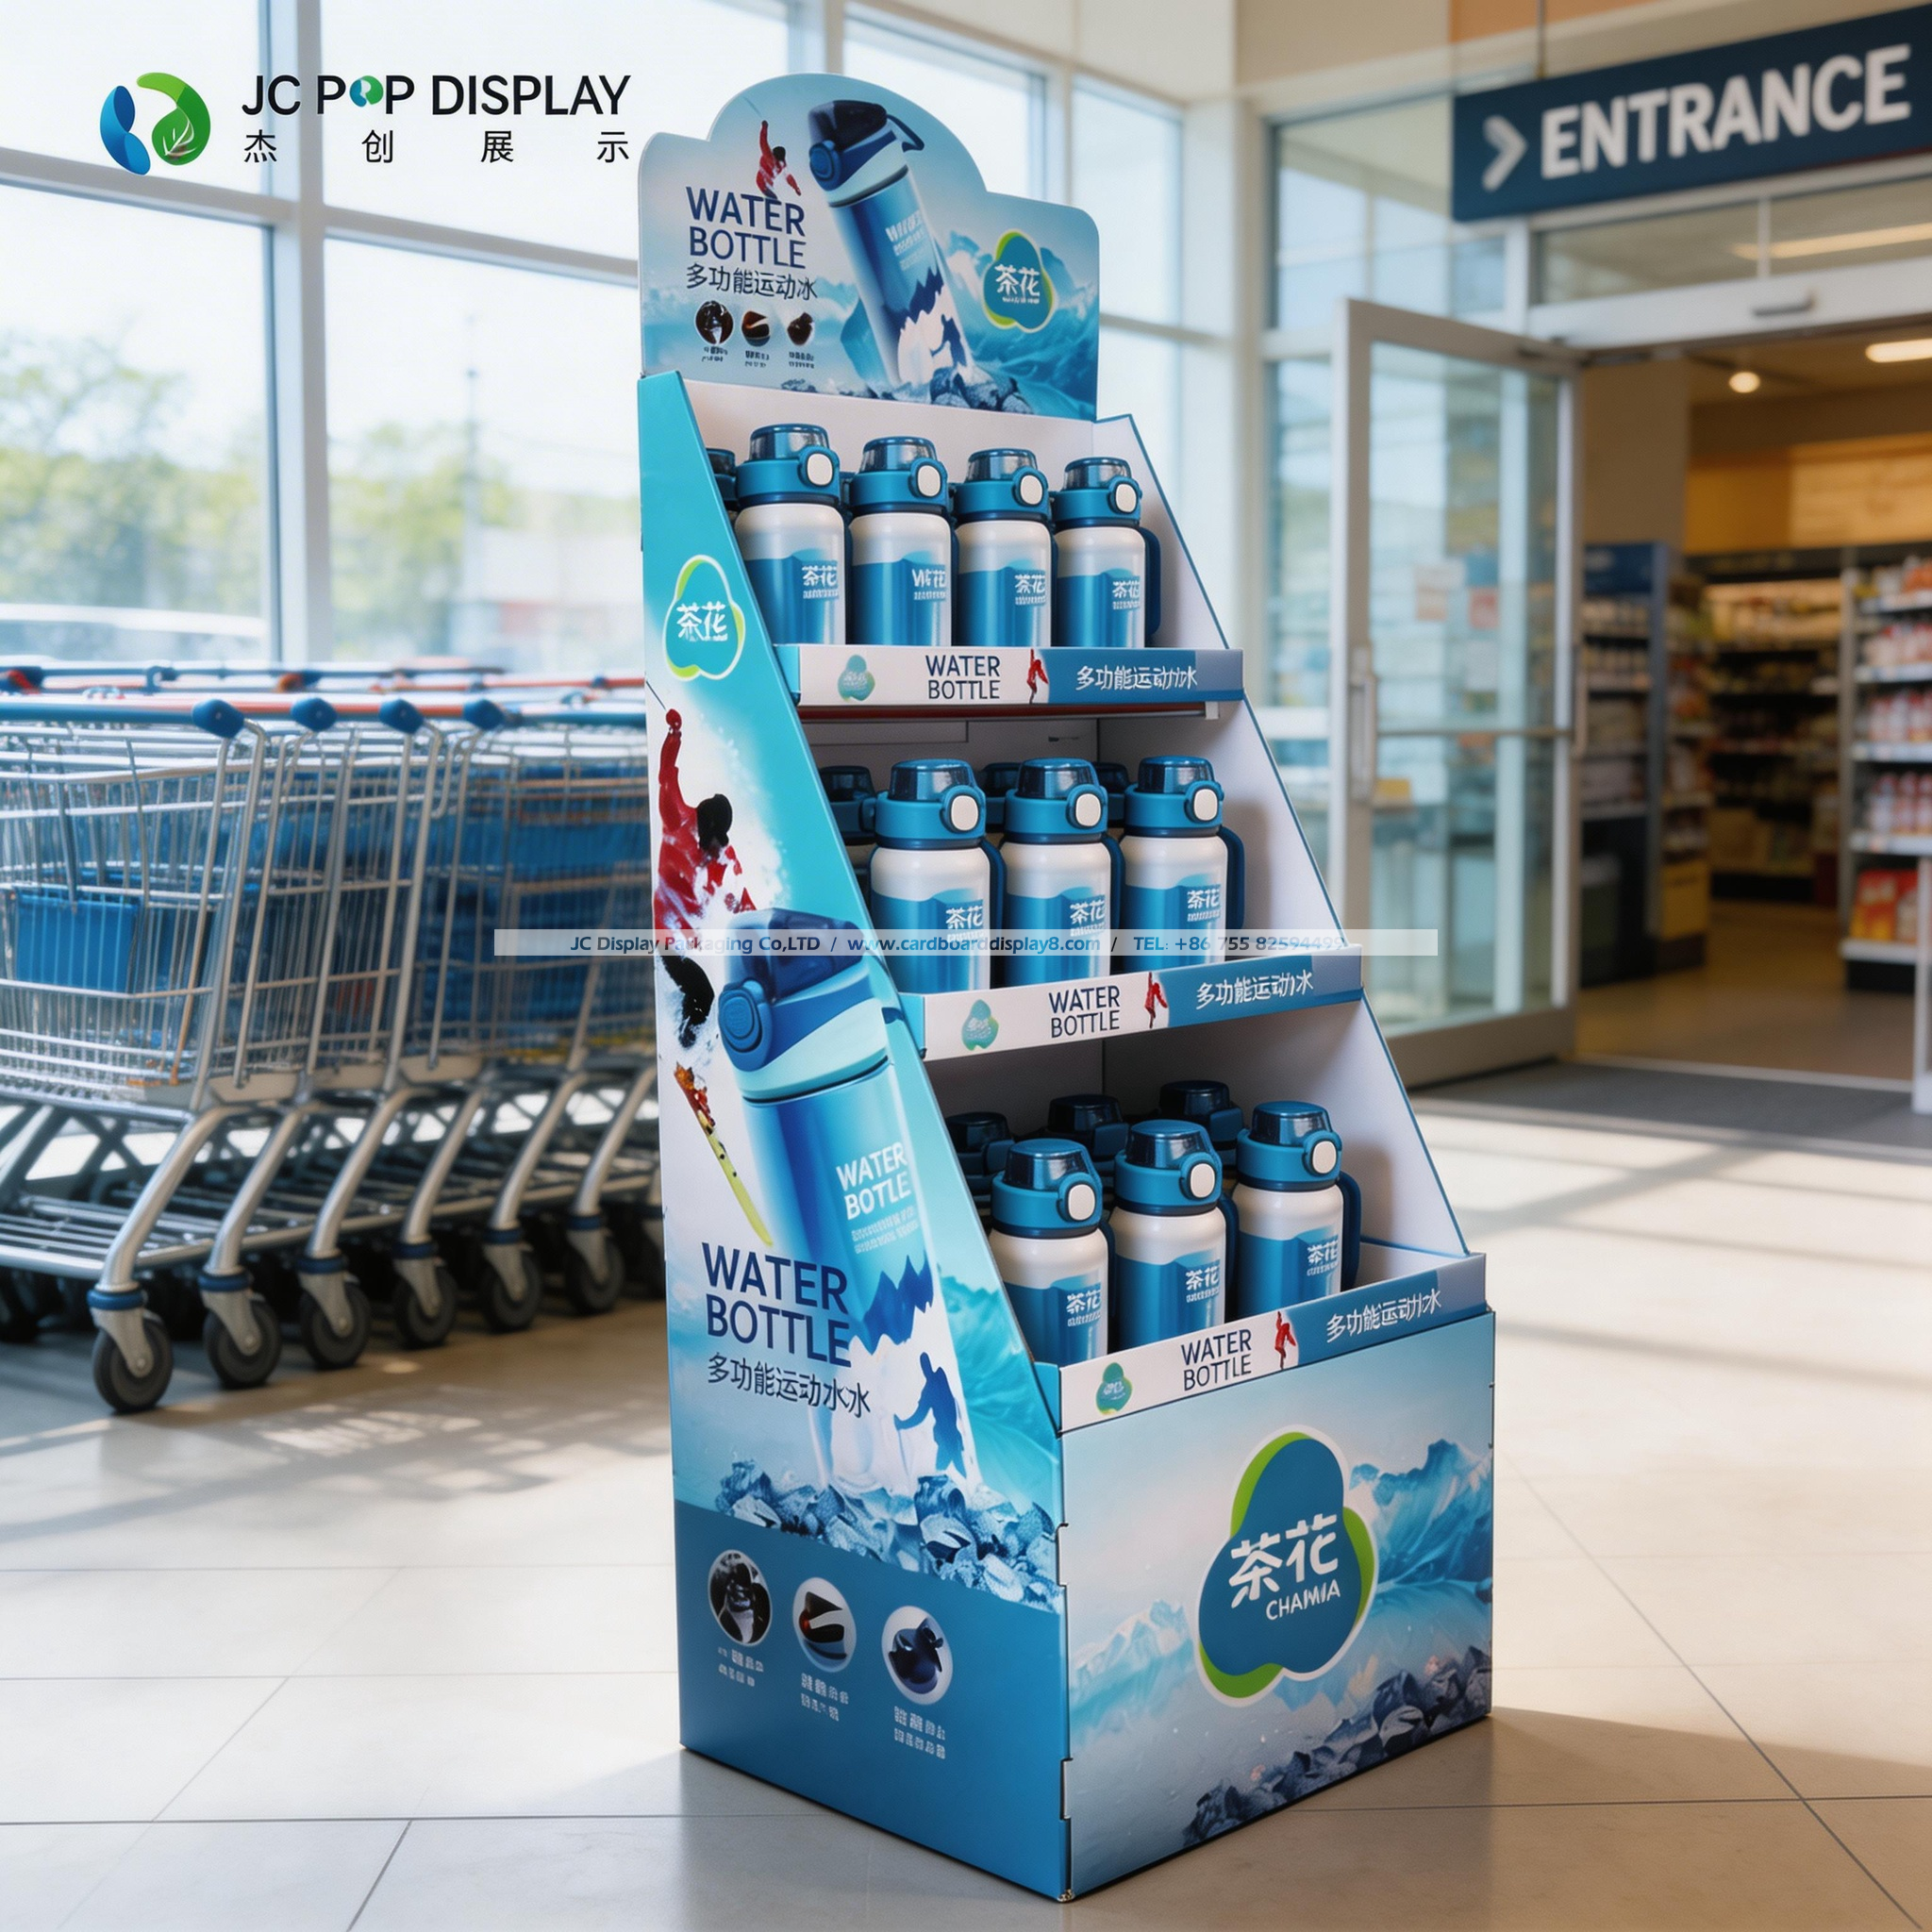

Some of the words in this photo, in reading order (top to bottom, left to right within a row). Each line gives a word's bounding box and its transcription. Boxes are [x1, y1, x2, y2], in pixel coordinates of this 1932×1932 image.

[1541, 43, 1911, 179] ENTRANCE
[686, 186, 806, 237] WATER
[690, 225, 807, 269] BOTTLE
[994, 263, 1041, 297] 茶花
[676, 601, 728, 641] 茶花
[925, 655, 1000, 676] WATER
[928, 680, 1001, 699] BOTTLE
[1070, 900, 1105, 925] 茶花
[1187, 889, 1220, 909] 茶花
[945, 906, 983, 930] 茶花
[1048, 985, 1120, 1013] WATER
[1051, 1009, 1120, 1039] BOTTLE
[836, 1141, 908, 1191] WATER
[702, 1241, 849, 1316] WATER
[1185, 1265, 1220, 1291] 茶花
[1066, 1289, 1102, 1314] 茶花
[706, 1293, 852, 1368] BOTTLE
[1181, 1328, 1252, 1366] WATER
[1184, 1354, 1252, 1391] BOTTLE
[1228, 1513, 1338, 1608] 茶花
